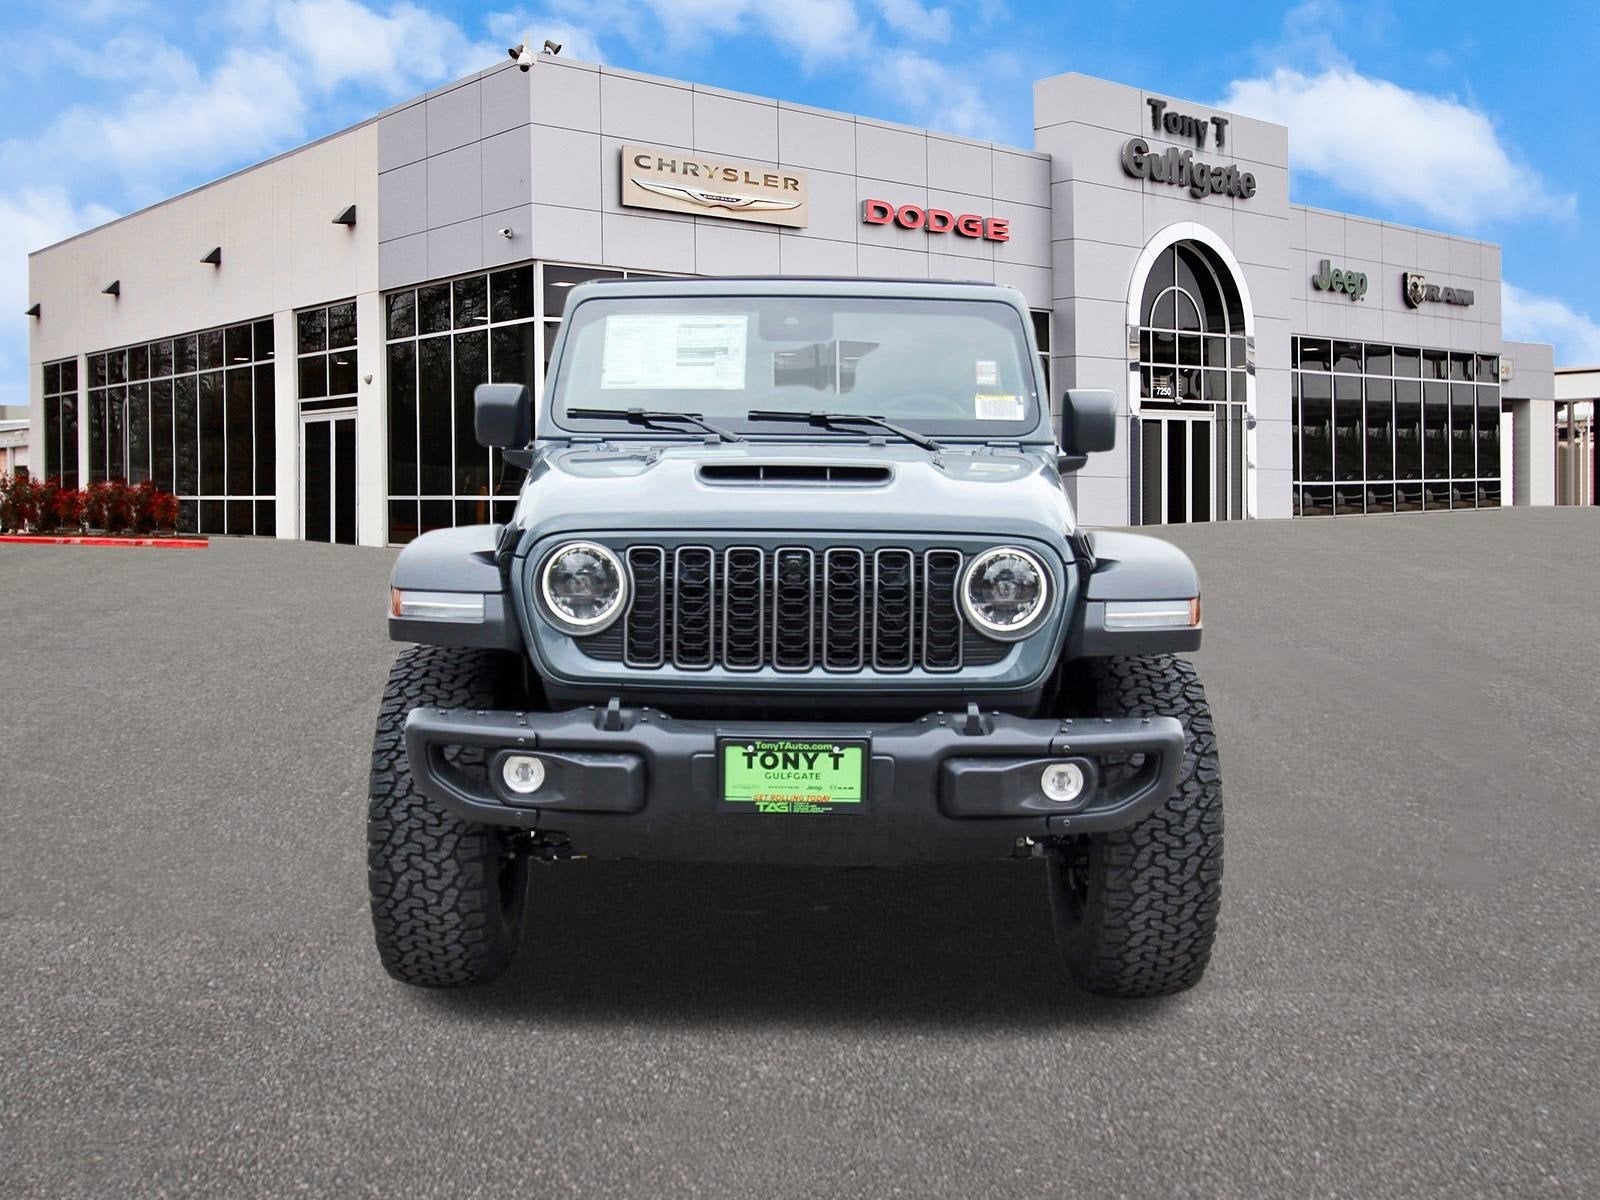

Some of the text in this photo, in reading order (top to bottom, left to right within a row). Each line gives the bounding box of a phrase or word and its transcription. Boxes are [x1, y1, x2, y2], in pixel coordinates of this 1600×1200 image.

[1147, 98, 1229, 148] Tony T
[633, 153, 800, 192] CHRYSLER
[1121, 138, 1256, 199] Gulfgate
[863, 198, 1011, 242] DODGE
[1312, 259, 1368, 302] Jeep
[1425, 284, 1475, 306] RAM
[1156, 386, 1172, 396] 7250
[755, 741, 833, 752] TonyTAuto.com
[742, 751, 844, 770] TONY T
[764, 772, 821, 780] GULFGATE
[753, 794, 832, 803] GET ROLLING TODAY
